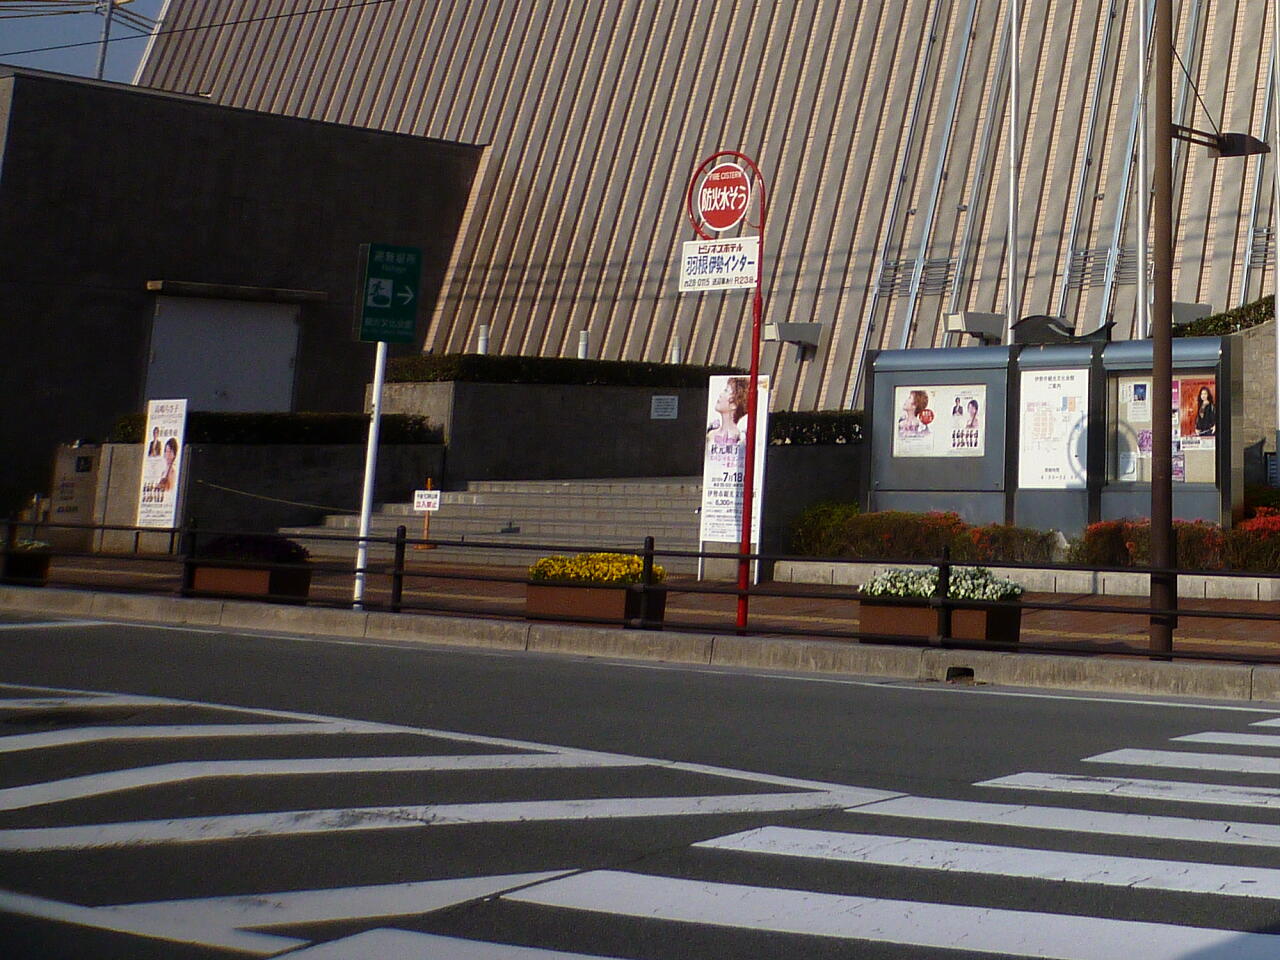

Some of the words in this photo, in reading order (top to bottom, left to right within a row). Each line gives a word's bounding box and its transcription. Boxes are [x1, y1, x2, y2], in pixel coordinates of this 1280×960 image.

[701, 185, 747, 212] 防火水そう
[698, 243, 743, 254] ビジネスホテル
[685, 254, 755, 275] 羽根伊勢インター
